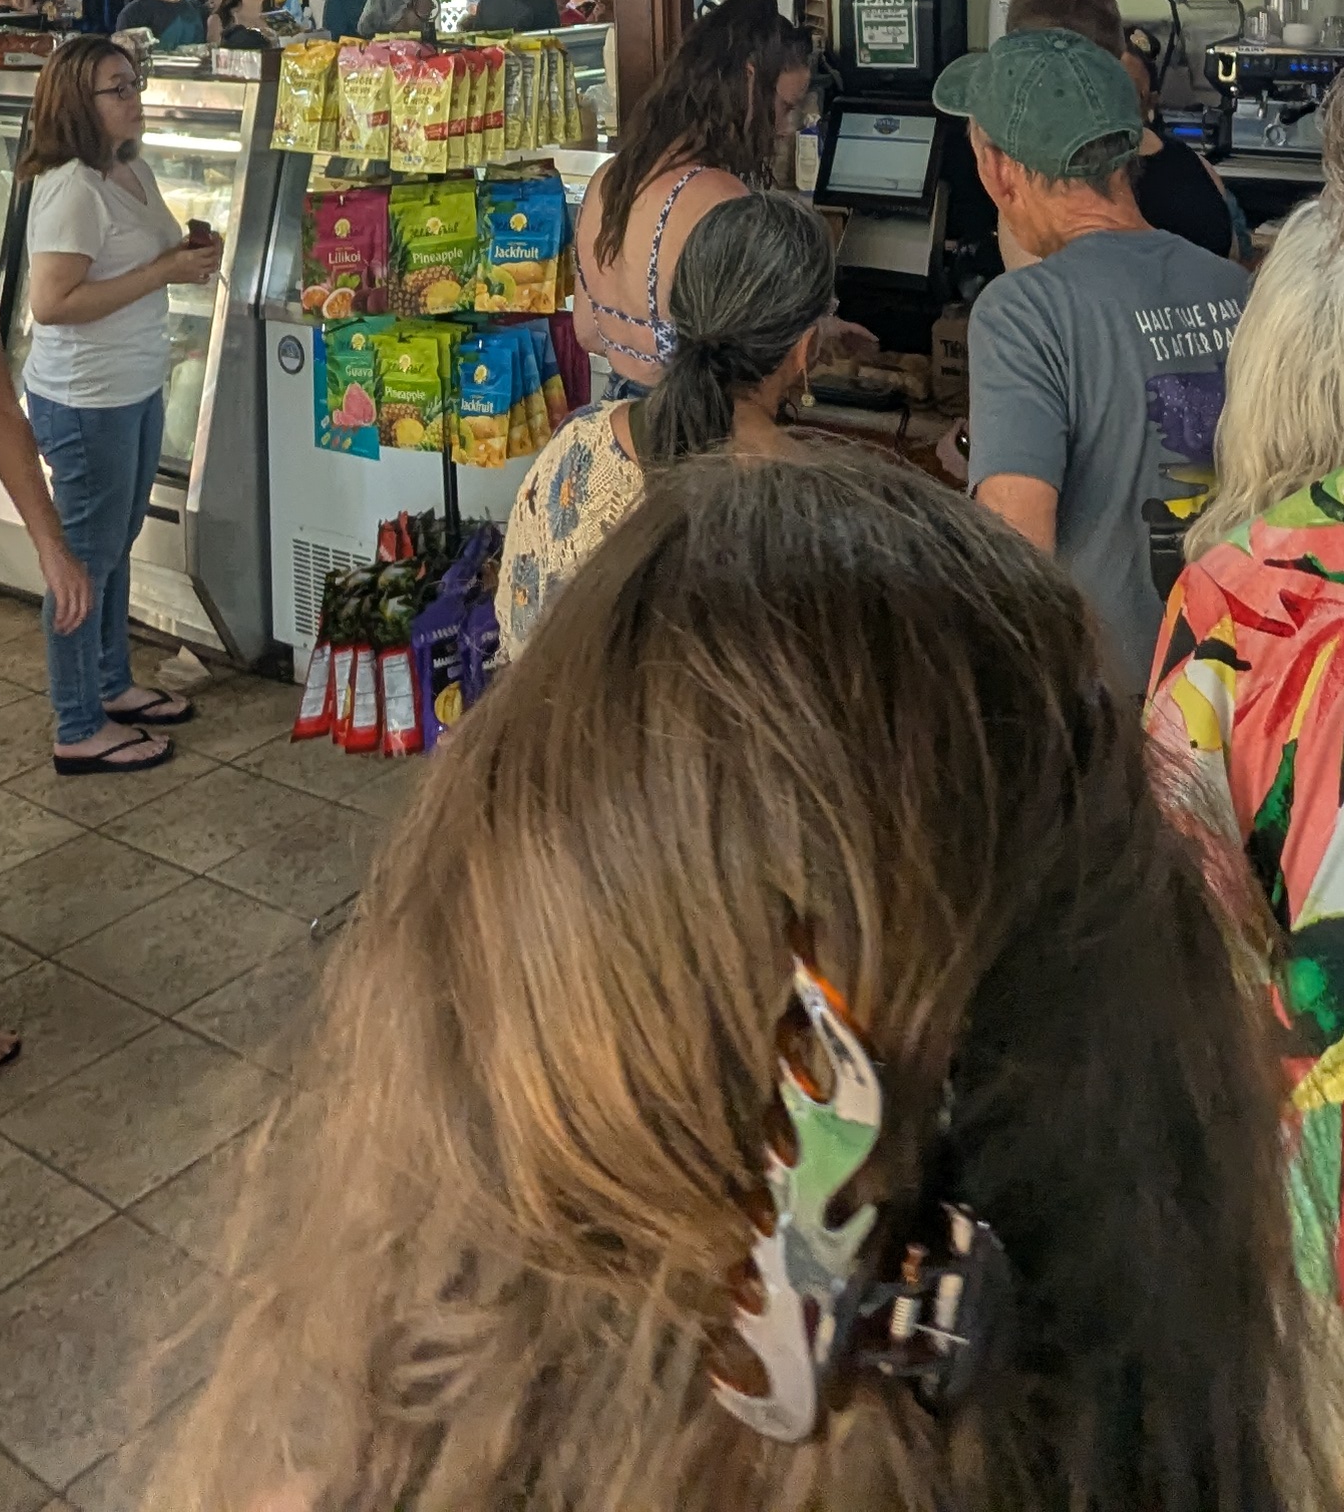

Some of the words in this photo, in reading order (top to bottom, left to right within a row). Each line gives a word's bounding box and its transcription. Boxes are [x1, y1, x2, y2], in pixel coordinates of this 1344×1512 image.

[328, 251, 361, 263] Lilikoi
[412, 249, 463, 265] Pineapple
[494, 245, 539, 259] Jackfruit
[1136, 307, 1173, 334] HALF
[1175, 305, 1206, 328] THE
[1149, 336, 1170, 361] IS
[1171, 332, 1213, 358] AFTER
[1213, 327, 1235, 350] DA
[345, 365, 373, 377] Guava
[385, 386, 426, 402] Pineapple
[461, 399, 494, 414] Jackfruit
